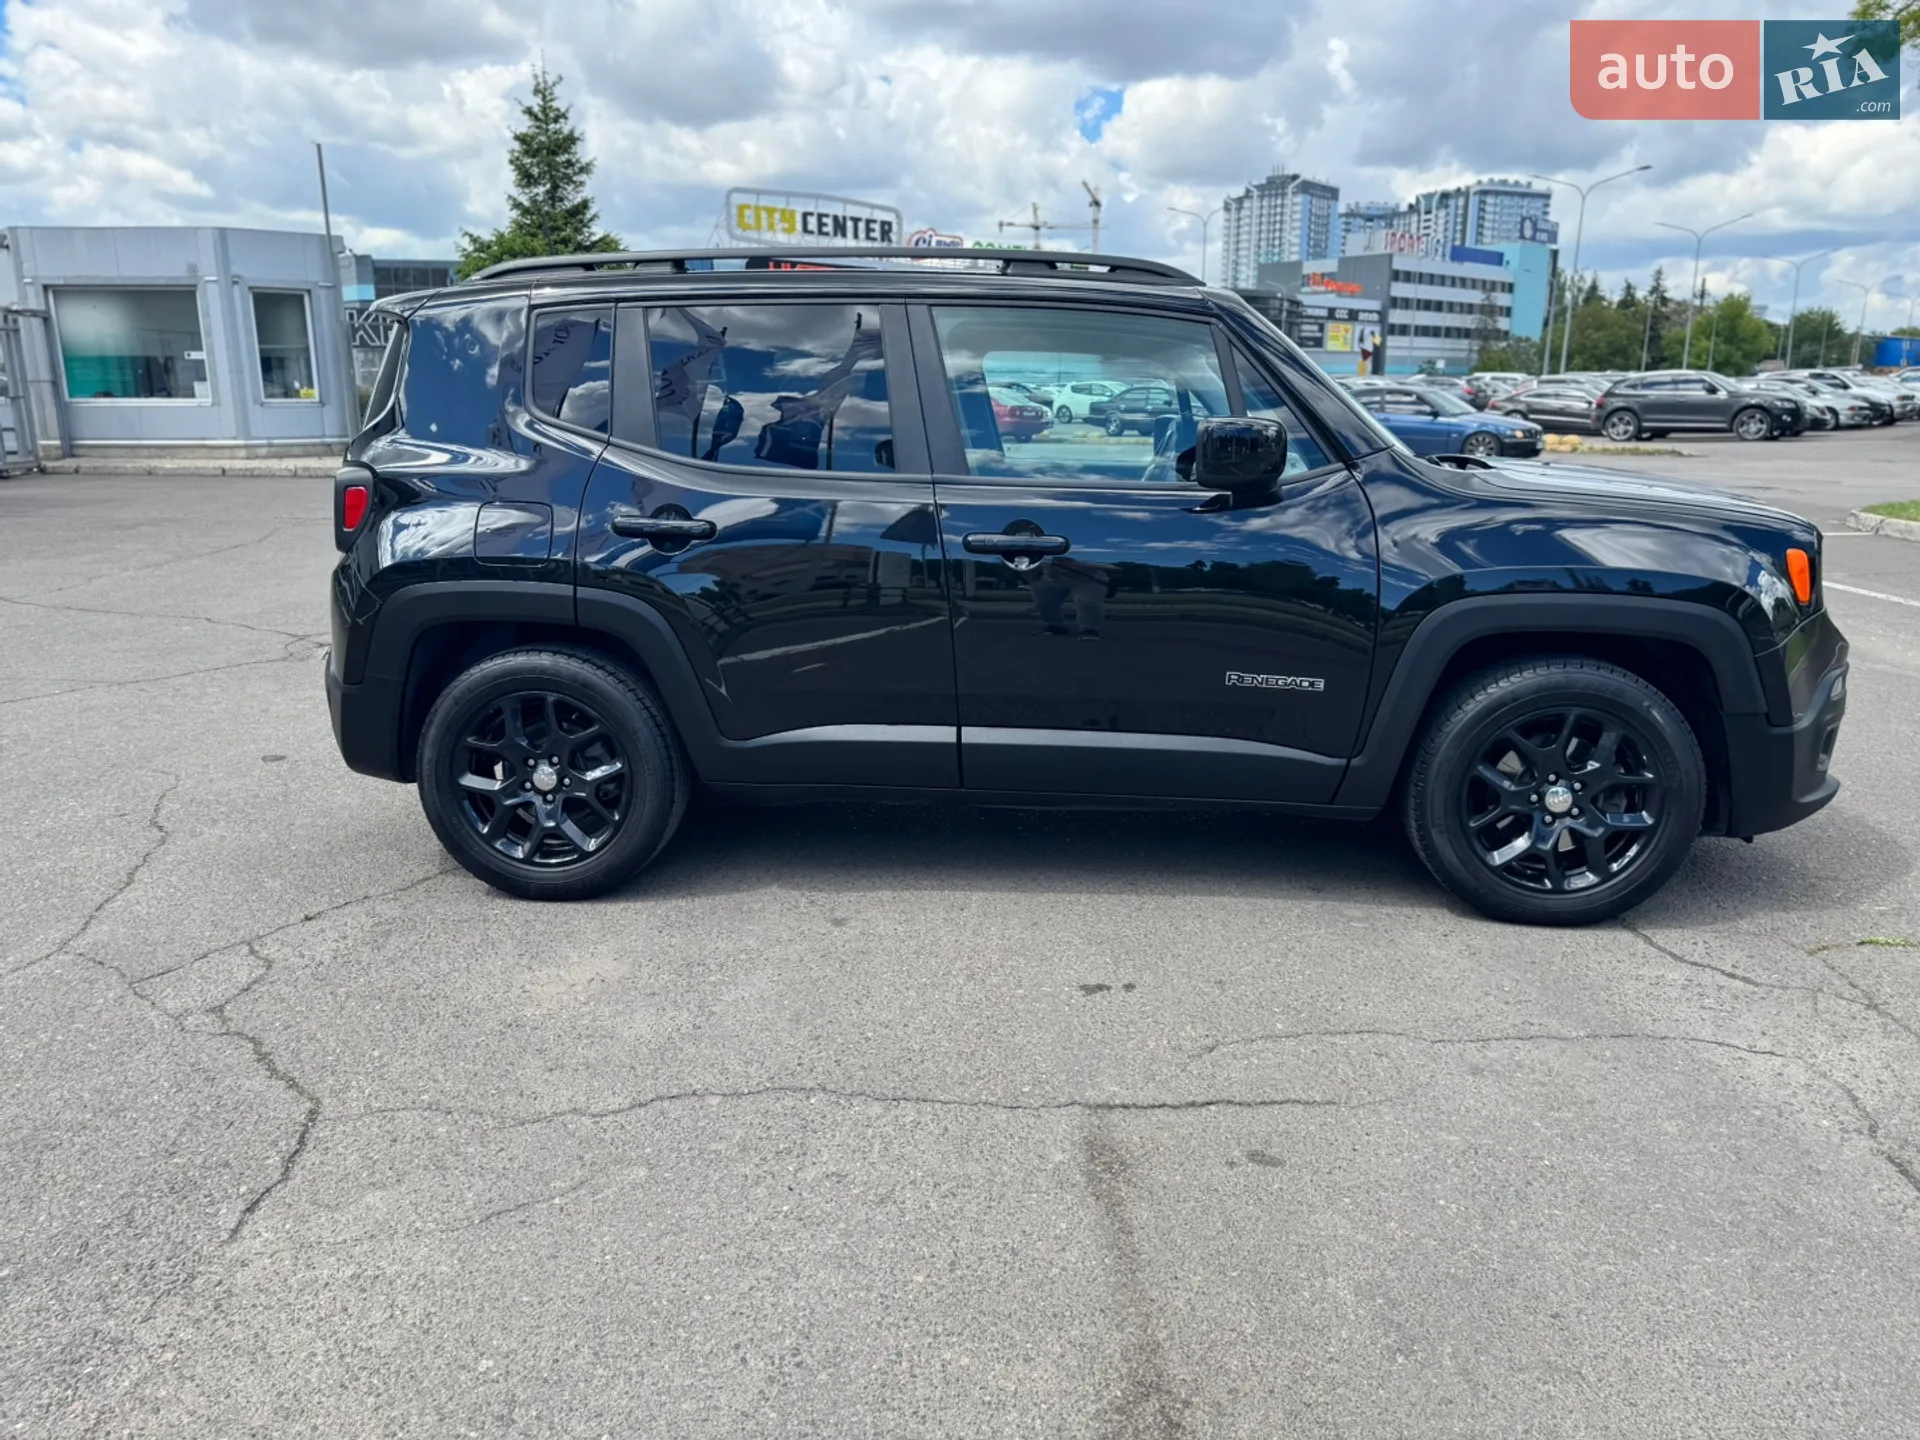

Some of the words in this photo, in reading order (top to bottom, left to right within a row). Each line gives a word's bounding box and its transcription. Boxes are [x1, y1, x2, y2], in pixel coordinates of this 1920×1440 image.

[737, 203, 798, 235] CITY
[801, 211, 894, 242] CENTER
[1225, 671, 1325, 692] RENEGADE
